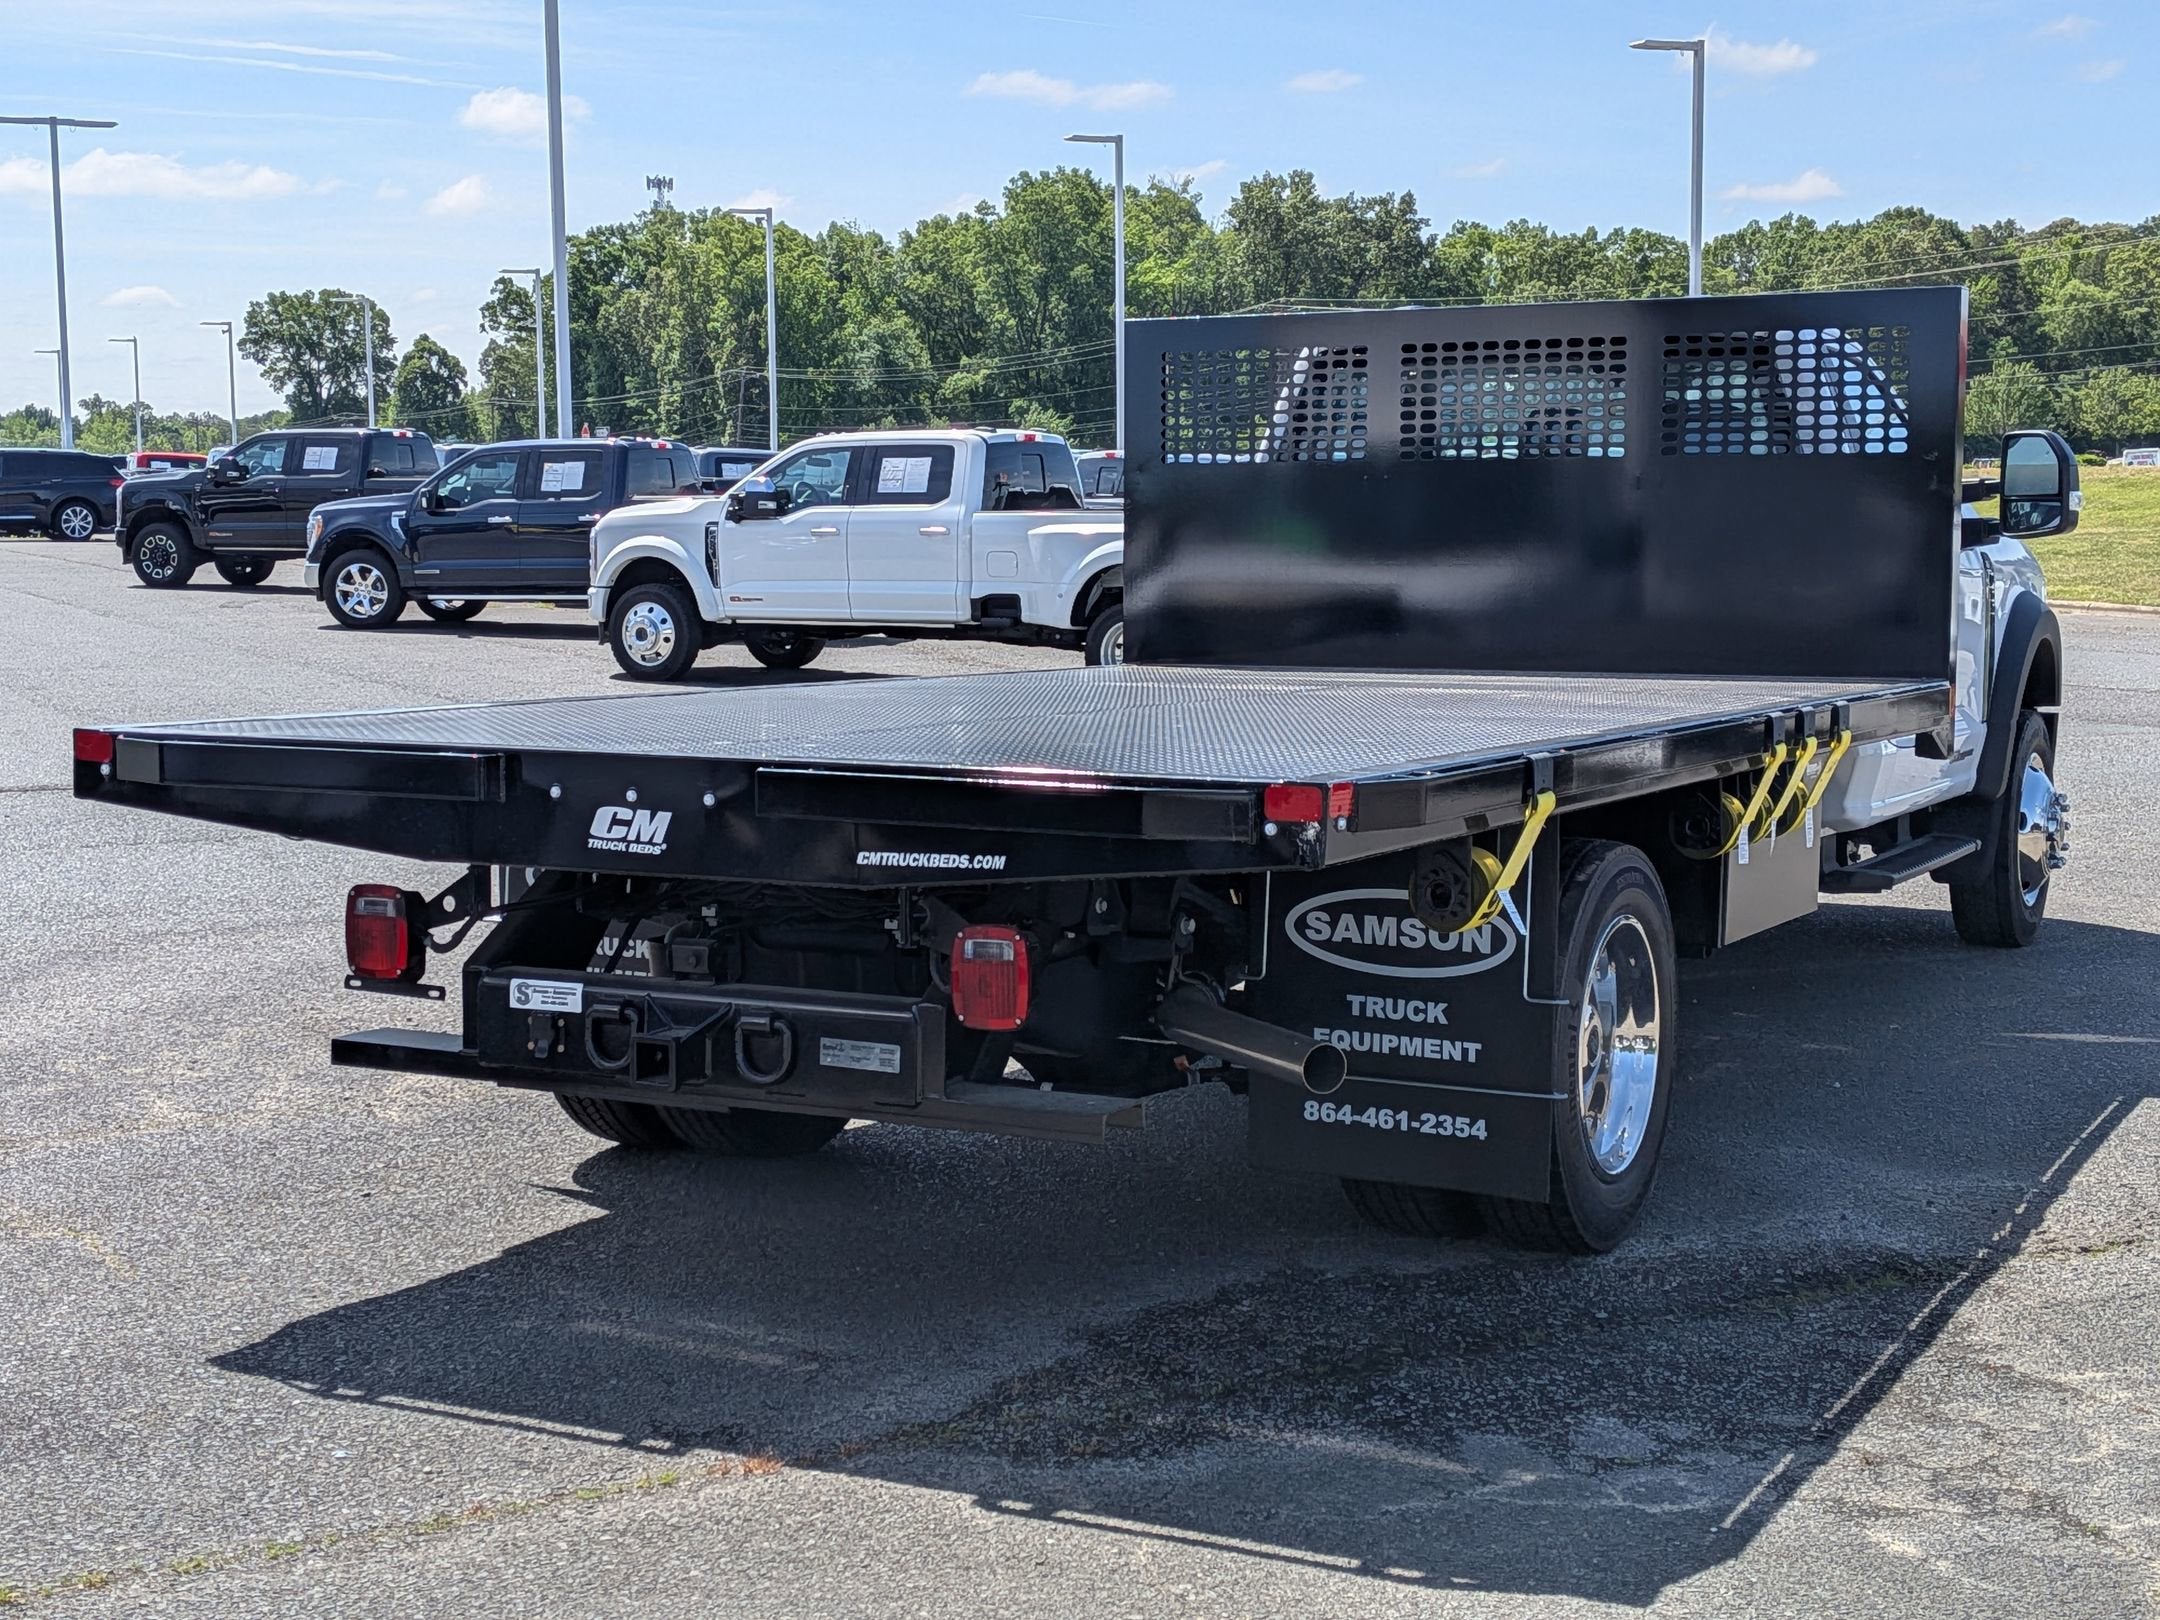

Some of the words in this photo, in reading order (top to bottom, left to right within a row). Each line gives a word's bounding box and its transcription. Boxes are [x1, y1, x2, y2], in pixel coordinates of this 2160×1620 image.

[589, 806, 672, 844] CM
[587, 838, 627, 852] TRUCK
[856, 851, 1006, 870] CMTRUCKBEDS.COM
[1305, 911, 1492, 954] SAMSON
[1346, 994, 1448, 1025] TRUCK
[1313, 1028, 1482, 1062] EQUIPMENT
[1303, 1100, 1488, 1140] 864-461-2354
